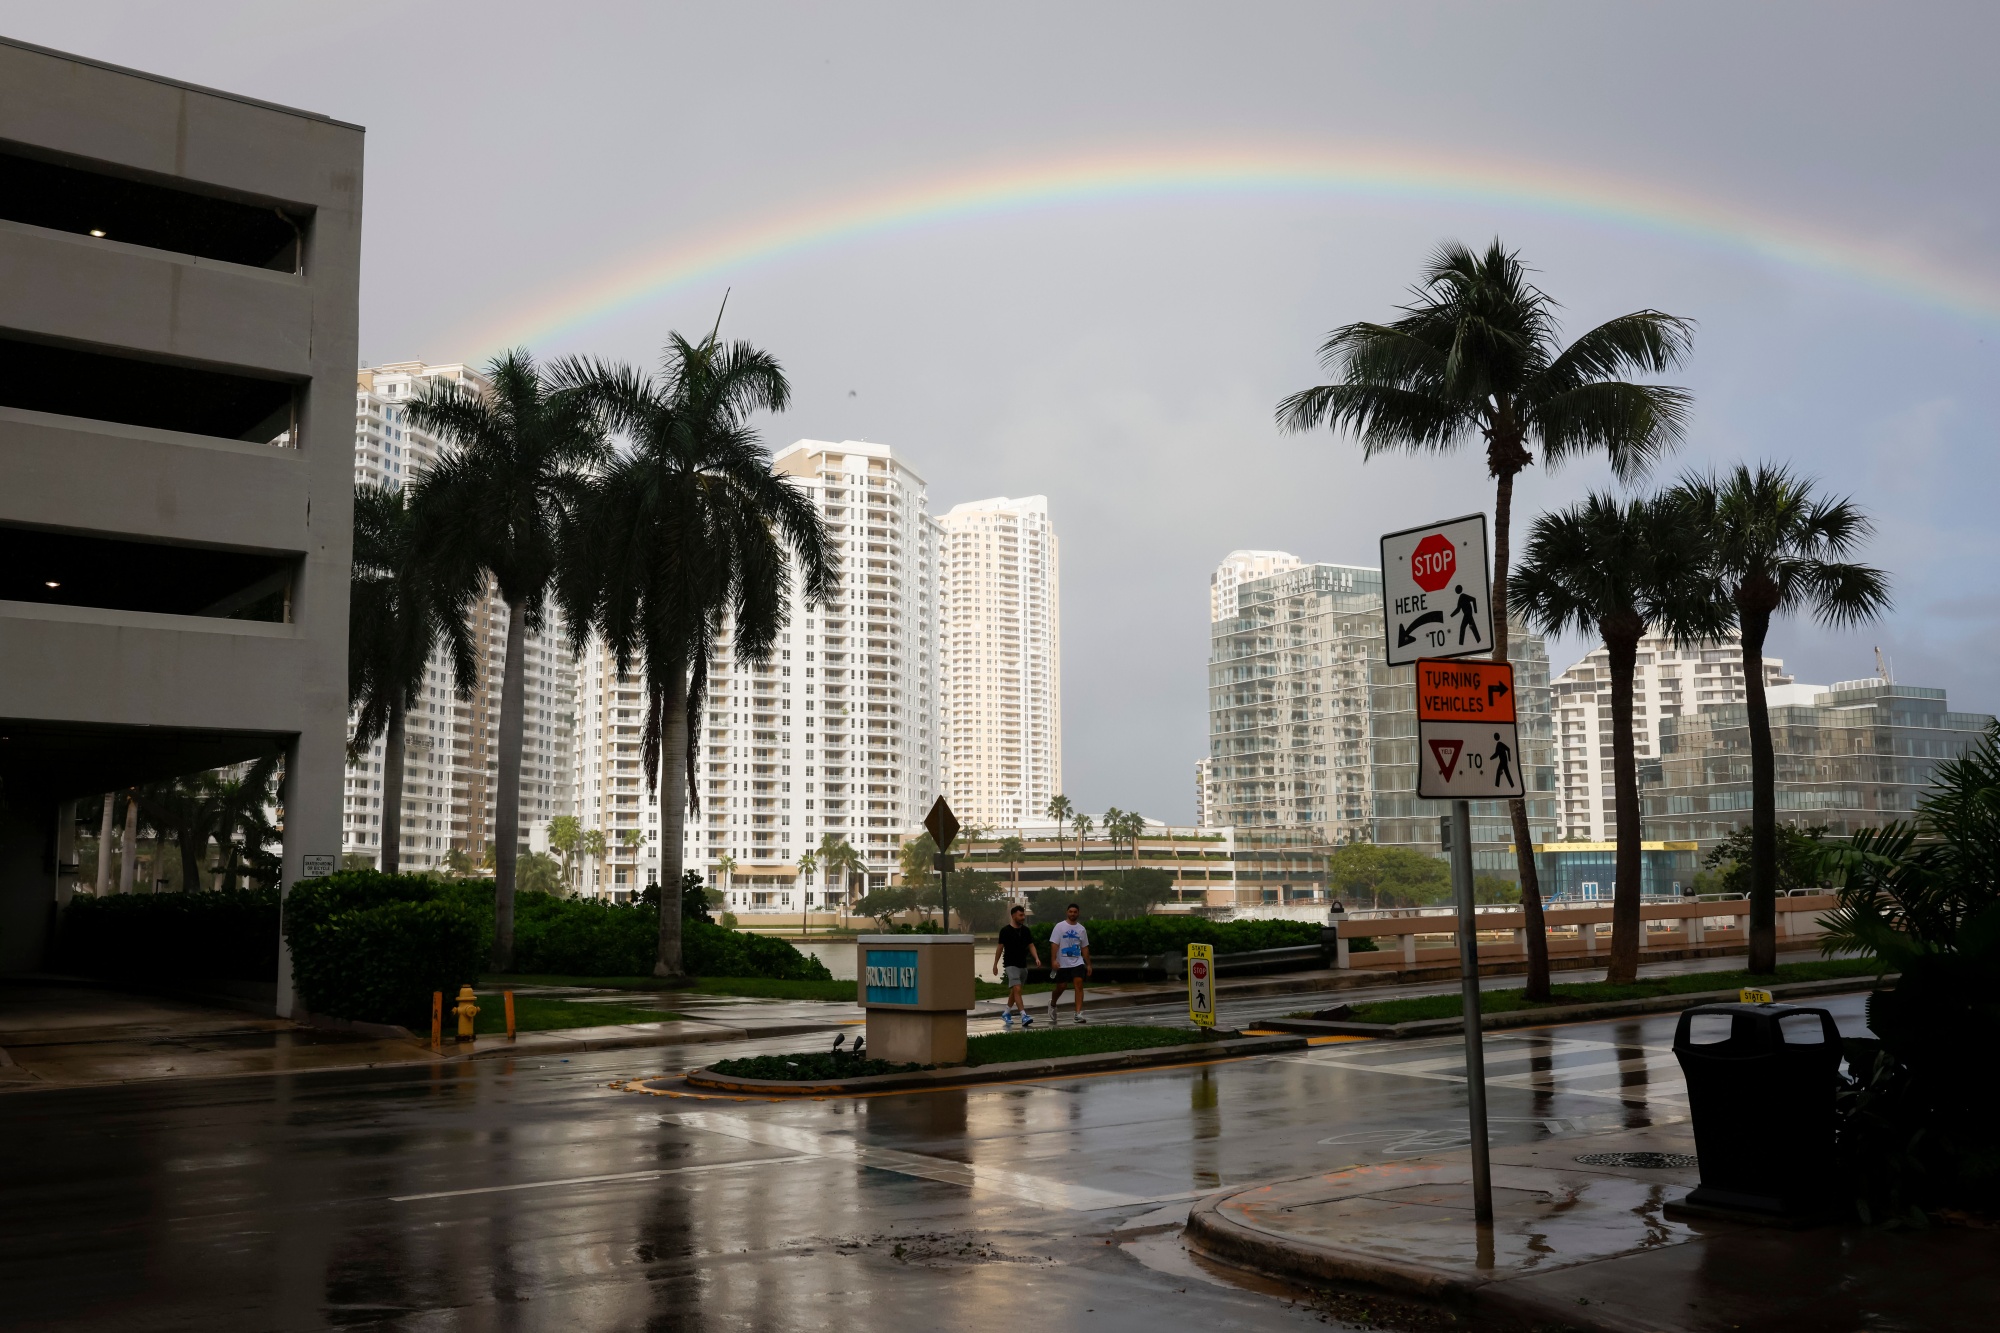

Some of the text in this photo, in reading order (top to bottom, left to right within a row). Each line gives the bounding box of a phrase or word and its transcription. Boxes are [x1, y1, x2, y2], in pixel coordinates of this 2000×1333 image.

[1414, 549, 1453, 577] STOP
[1395, 594, 1428, 615] HERE
[1430, 630, 1445, 648] TO
[1425, 670, 1481, 688] TURNING
[1424, 696, 1484, 712] VEHICLES
[1466, 754, 1482, 768] TO
[866, 966, 916, 988] BRICKELL KEY
[1745, 992, 1764, 1001] STATE
